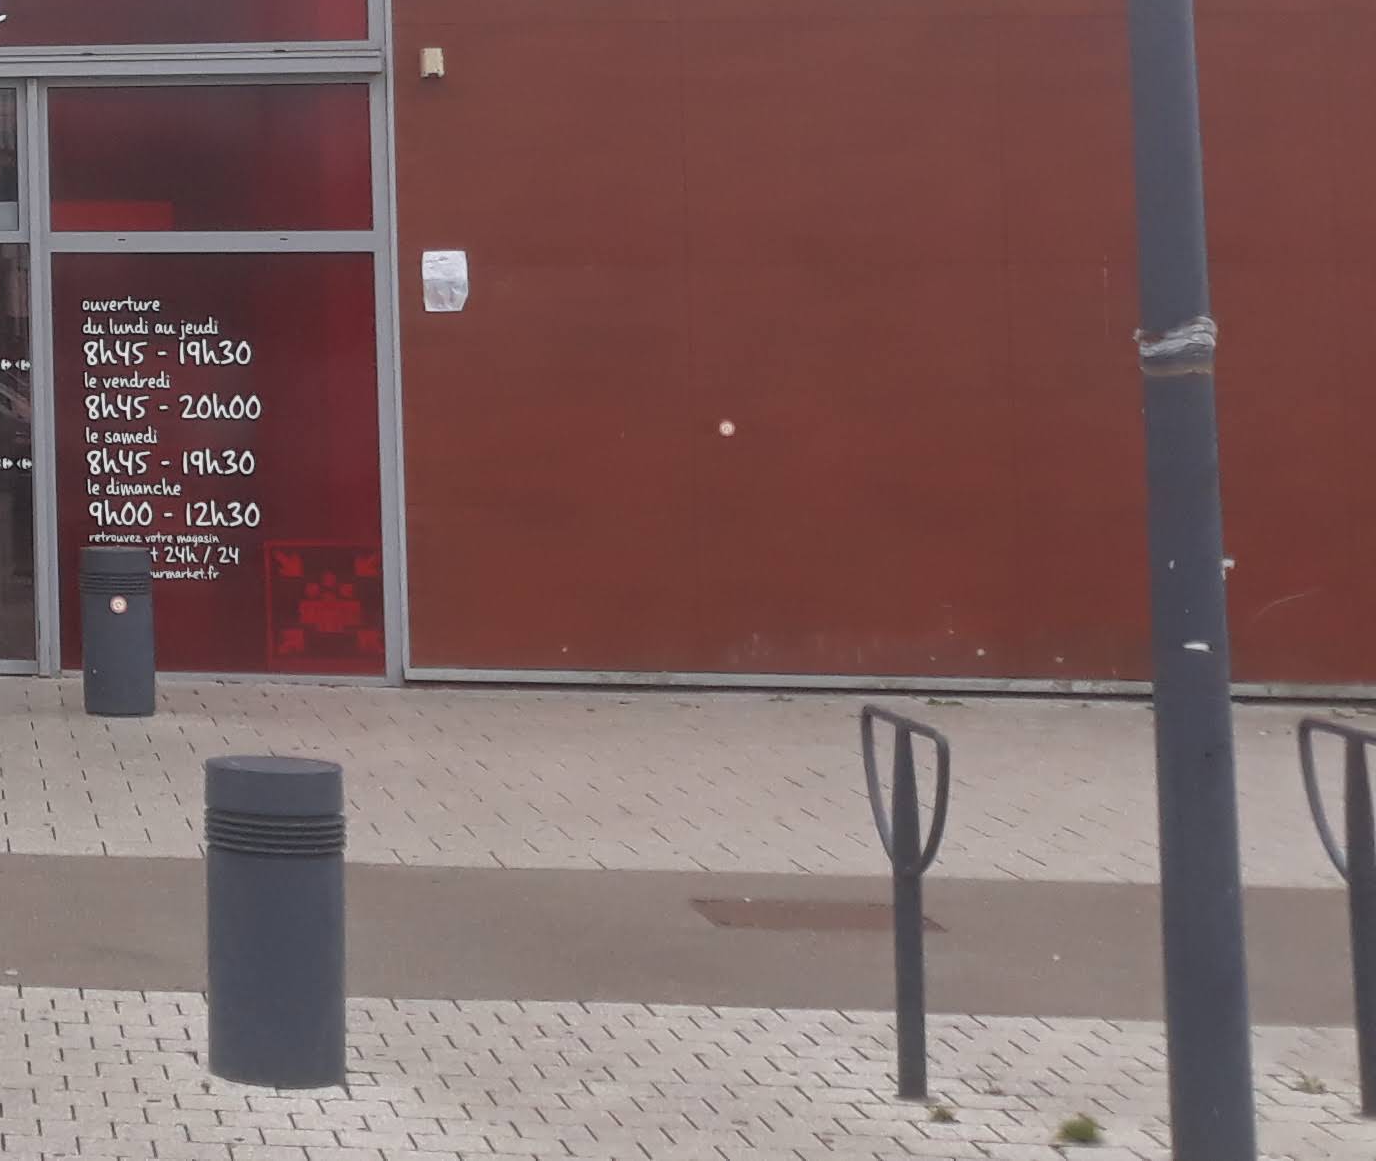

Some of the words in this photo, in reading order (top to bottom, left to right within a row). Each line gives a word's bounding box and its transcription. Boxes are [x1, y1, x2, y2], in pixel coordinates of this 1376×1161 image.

[82, 296, 160, 312] ouverture
[82, 317, 105, 335] du
[109, 317, 149, 335] lundi
[154, 323, 176, 335] au
[178, 315, 219, 340] jeudi
[83, 339, 148, 366] 8h45
[178, 338, 252, 366] 19h30
[84, 371, 97, 389] le
[102, 370, 171, 389] vendredi
[84, 392, 150, 421] 8h45
[178, 392, 262, 420] 20h00
[85, 426, 99, 444] le
[104, 425, 158, 444] samedi
[86, 447, 152, 476] 8h45
[182, 447, 256, 476] 19h30
[87, 478, 100, 496] le
[105, 477, 182, 496] dimanche
[88, 499, 153, 527] 9h00
[185, 499, 261, 527] 12h30
[89, 531, 143, 543] retrouvez
[145, 530, 173, 543] votre
[176, 533, 220, 547] magasin
[163, 545, 199, 564] 24h
[217, 546, 240, 565] 24
[150, 565, 220, 581] urmarket.fr
